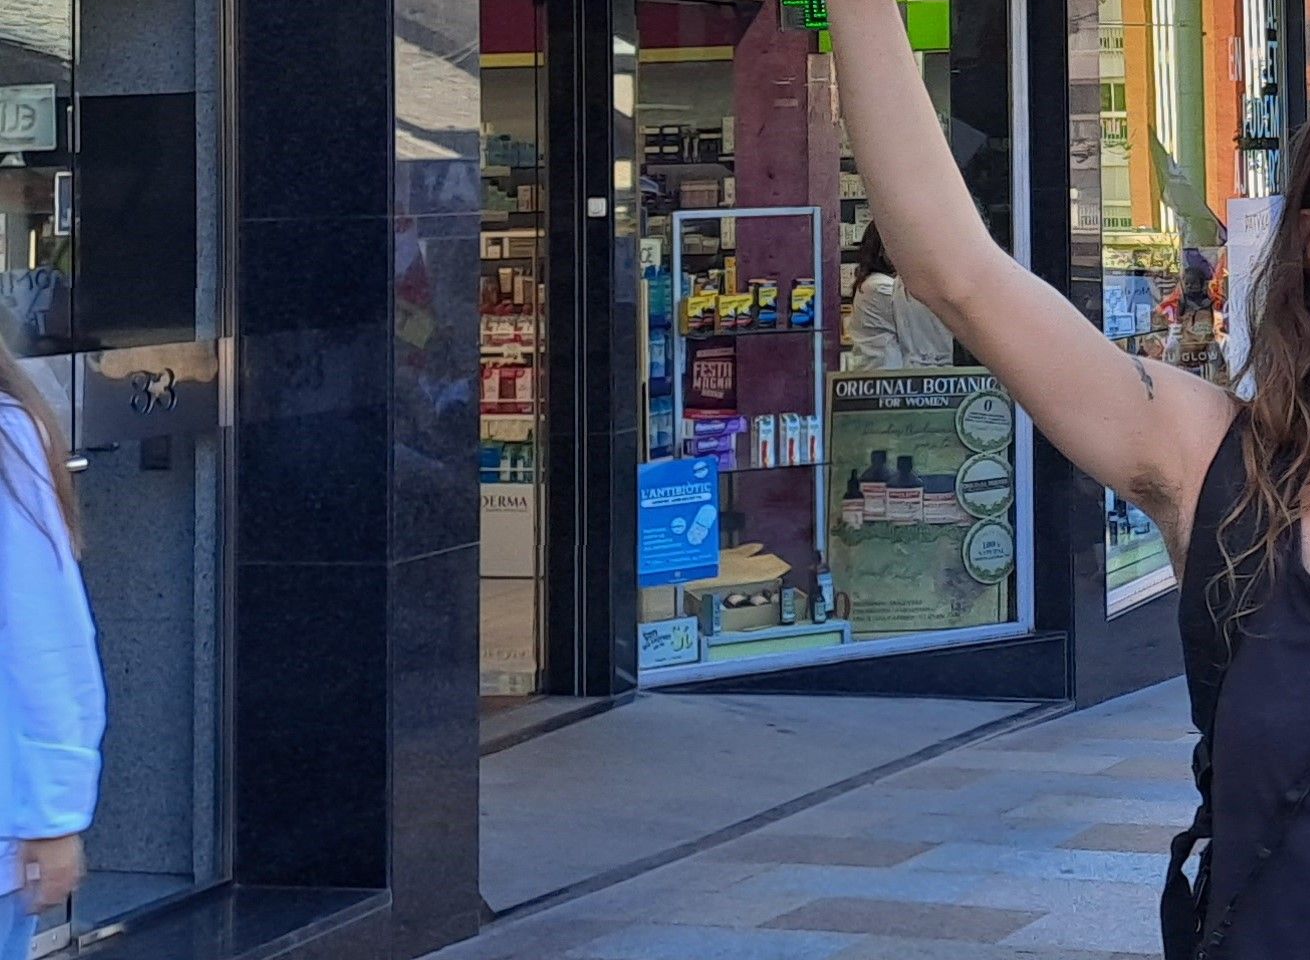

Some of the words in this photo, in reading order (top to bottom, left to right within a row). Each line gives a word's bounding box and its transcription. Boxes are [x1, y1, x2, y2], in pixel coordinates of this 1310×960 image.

[1182, 350, 1219, 362] GLOW
[836, 379, 919, 397] ORIGINAL
[879, 397, 901, 408] FOR
[905, 396, 950, 407] WOMEN
